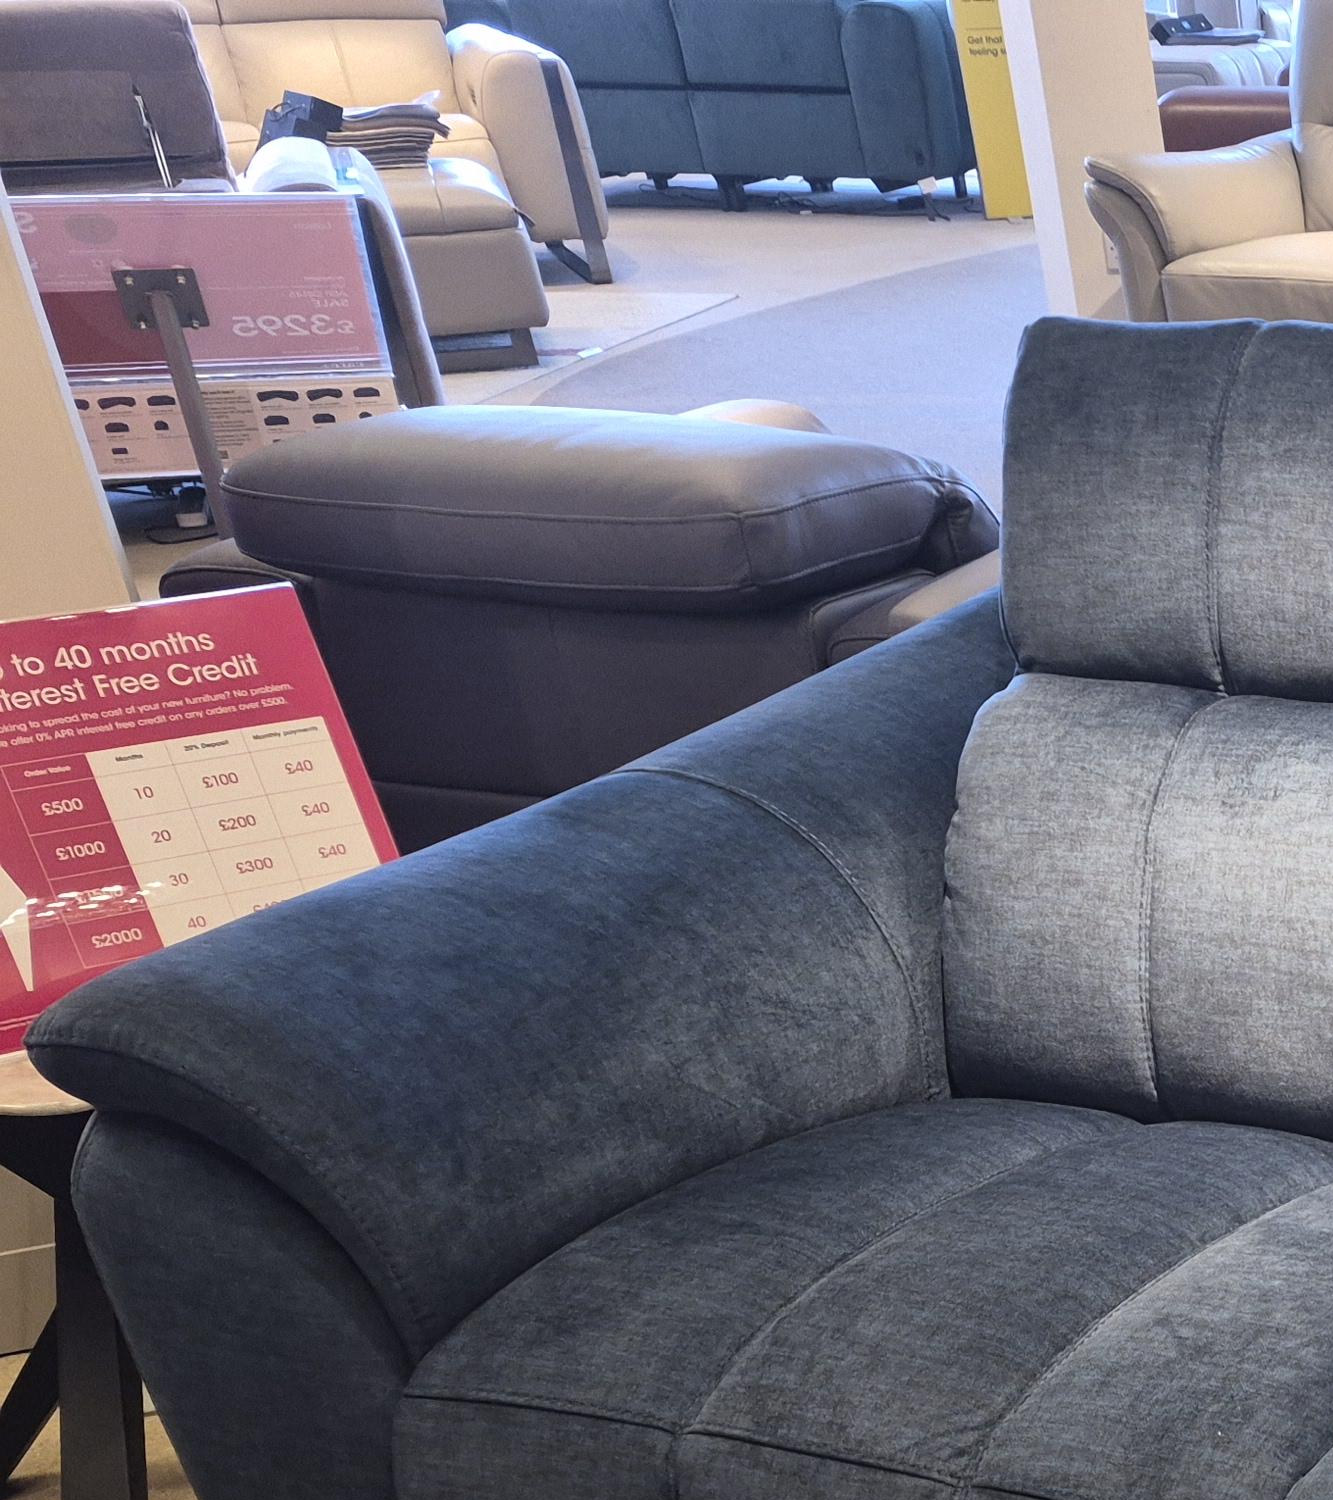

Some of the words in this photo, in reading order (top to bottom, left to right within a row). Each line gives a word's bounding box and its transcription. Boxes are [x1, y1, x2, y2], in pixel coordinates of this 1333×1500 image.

[967, 36, 983, 44] Get
[969, 47, 999, 57] feeling
[10, 653, 45, 677] to
[54, 644, 92, 670] 40
[99, 631, 215, 665] months
[0, 678, 87, 713] terest
[92, 673, 160, 698] Free
[167, 652, 260, 686] Credit
[0, 723, 27, 734] oking
[28, 720, 40, 729] to
[42, 714, 80, 728] spread
[80, 712, 99, 721] the
[101, 707, 123, 719] cost
[125, 705, 135, 715] of
[137, 703, 160, 715] your
[162, 699, 184, 709] new
[185, 691, 230, 705] furniture?
[232, 688, 248, 698] No
[249, 683, 295, 697] problem.
[10, 736, 34, 746] offer
[35, 732, 53, 742] 0%
[54, 728, 75, 740] APR
[76, 723, 114, 735] interest
[115, 720, 135, 730] free
[137, 714, 167, 727] credit
[168, 712, 183, 722] on
[184, 709, 203, 719] any
[205, 704, 238, 716] orders
[238, 701, 260, 711] over
[200, 739, 229, 749] Deposit
[284, 759, 313, 774] £40
[202, 771, 239, 788] £100
[133, 785, 154, 800] 10
[41, 797, 84, 816] £500
[301, 801, 330, 816] £40
[218, 814, 257, 831] £200
[151, 829, 172, 844] 20
[55, 840, 106, 861] £1000
[318, 843, 347, 858] £40
[235, 857, 273, 874] £300
[169, 872, 189, 887] 30
[187, 915, 207, 929] 40
[91, 927, 143, 949] £2000
